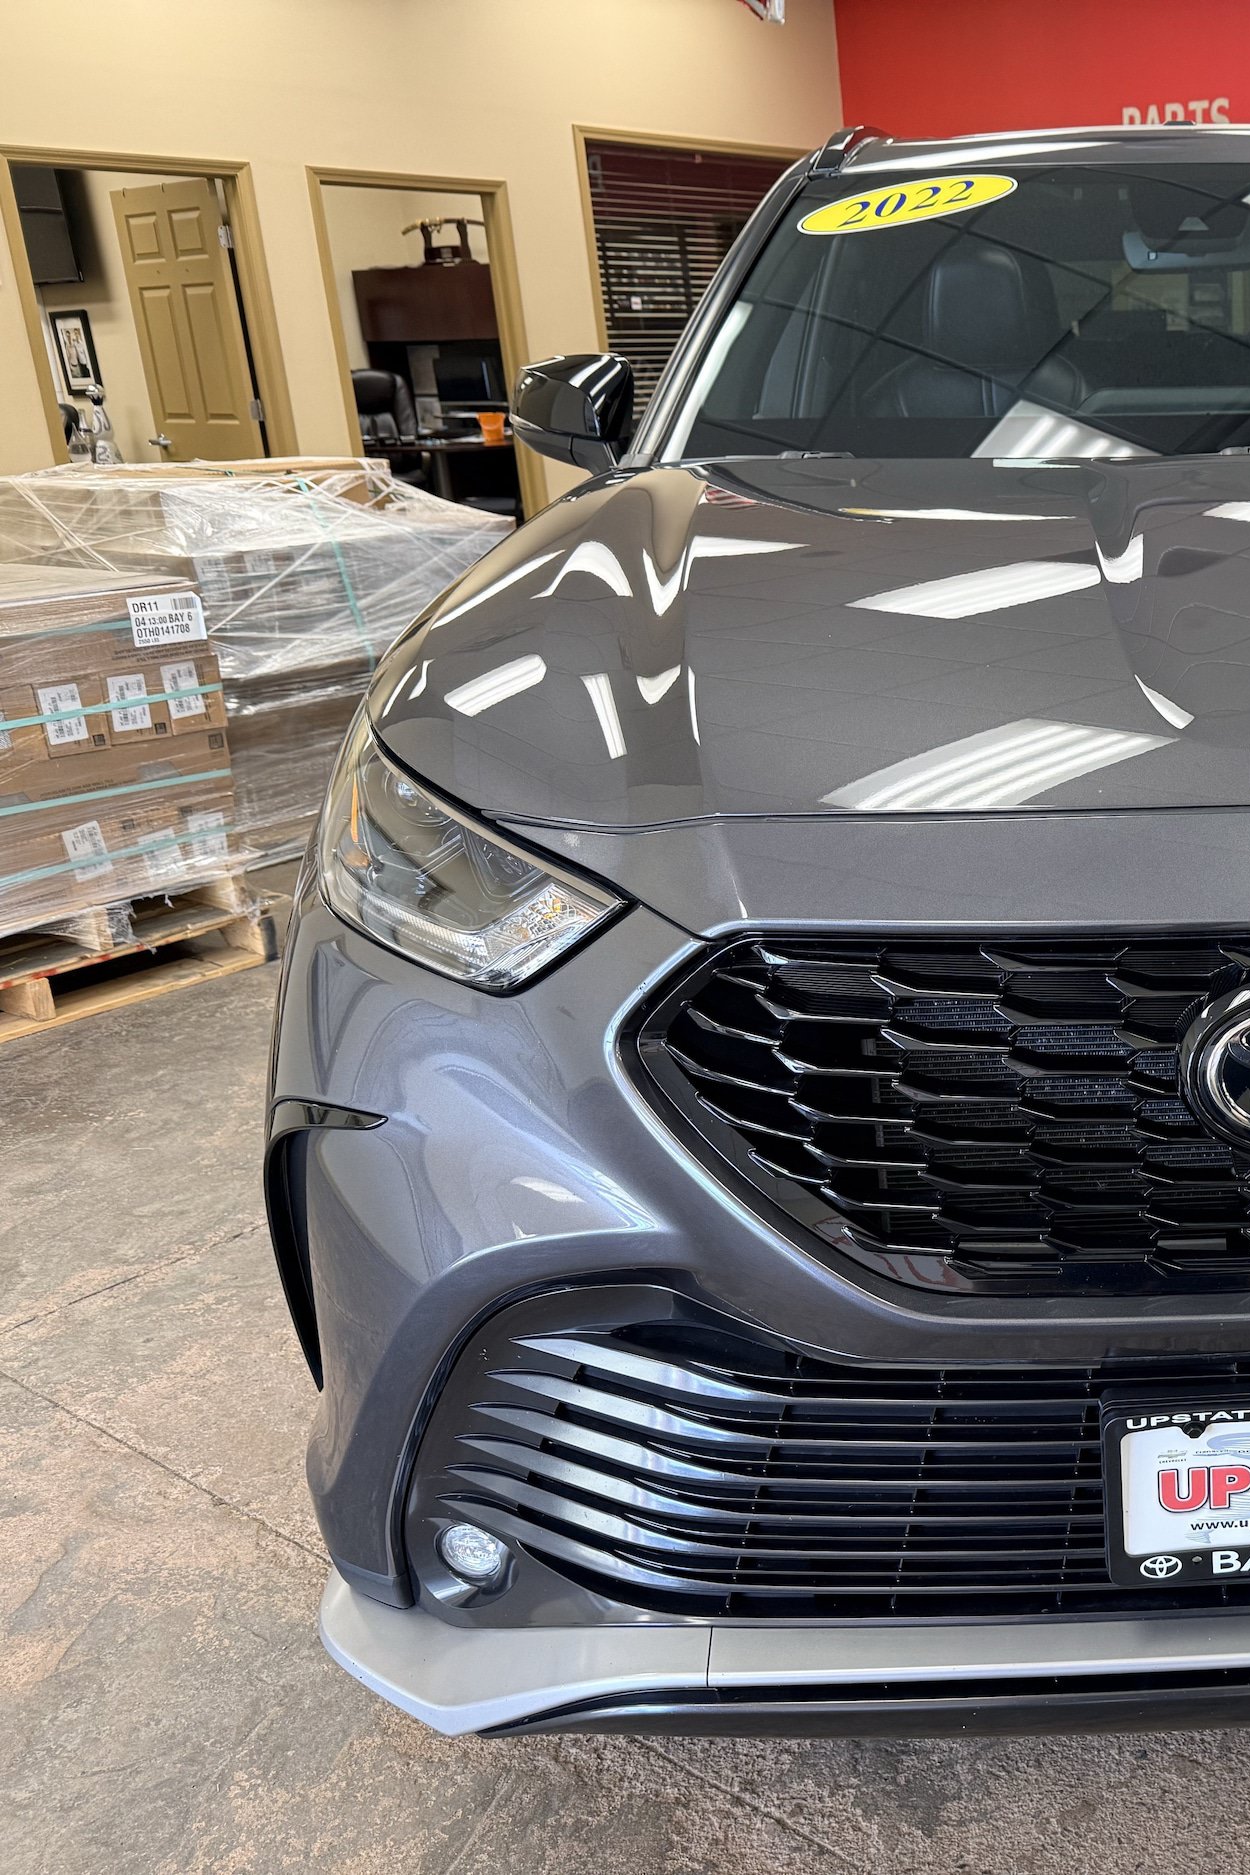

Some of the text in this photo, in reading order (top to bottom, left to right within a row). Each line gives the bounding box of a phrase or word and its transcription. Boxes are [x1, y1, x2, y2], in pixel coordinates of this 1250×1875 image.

[1122, 96, 1230, 125] PARTS
[837, 180, 975, 228] 2022
[132, 601, 159, 613] DR11
[135, 611, 193, 627] 04 13:00 BAY 6
